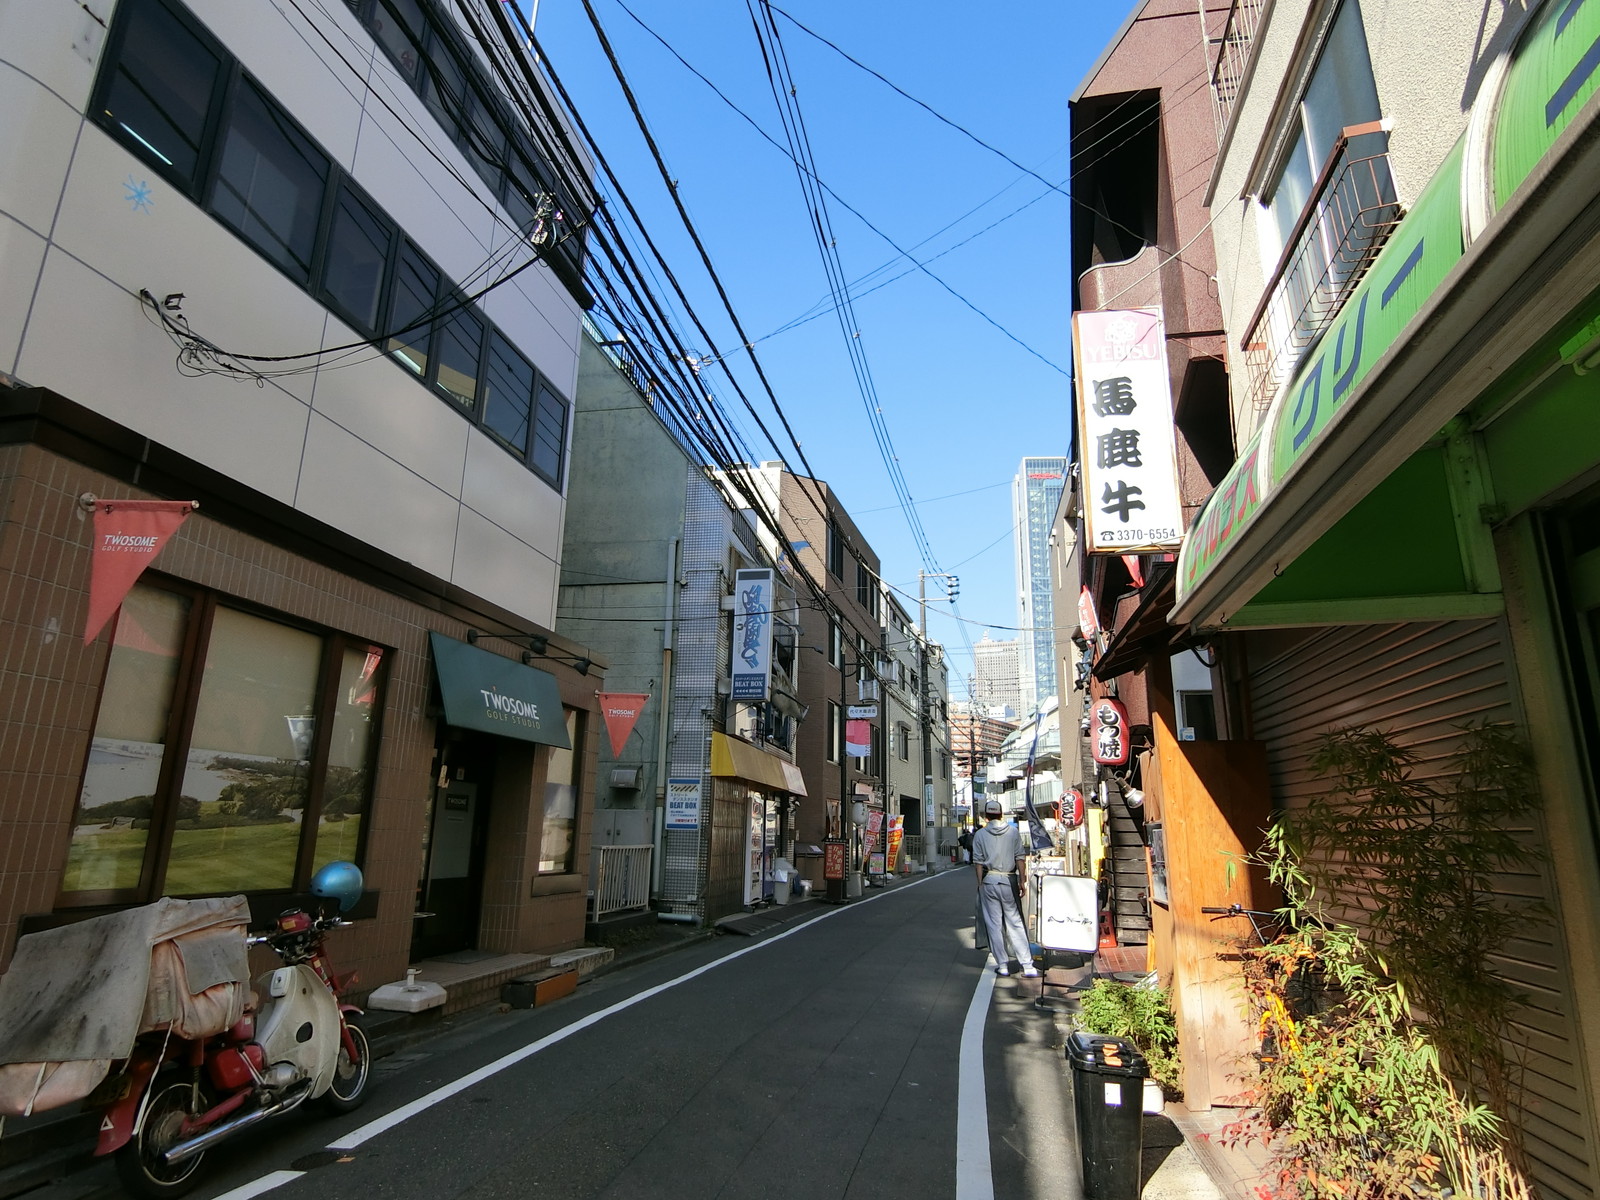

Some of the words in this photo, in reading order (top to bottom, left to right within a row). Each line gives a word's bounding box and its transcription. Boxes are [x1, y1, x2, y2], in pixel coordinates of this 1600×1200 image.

[1086, 343, 1157, 361] YEBISU
[1092, 376, 1146, 523] 馬鹿牛
[104, 534, 158, 547] TWOSOME
[1117, 528, 1176, 541] 3370-6554
[480, 689, 540, 720] TWOSOME
[608, 708, 636, 716] TWOSOME
[486, 709, 508, 721] GOLF
[511, 715, 541, 730] STUDIO
[1098, 705, 1121, 760] もつ焼
